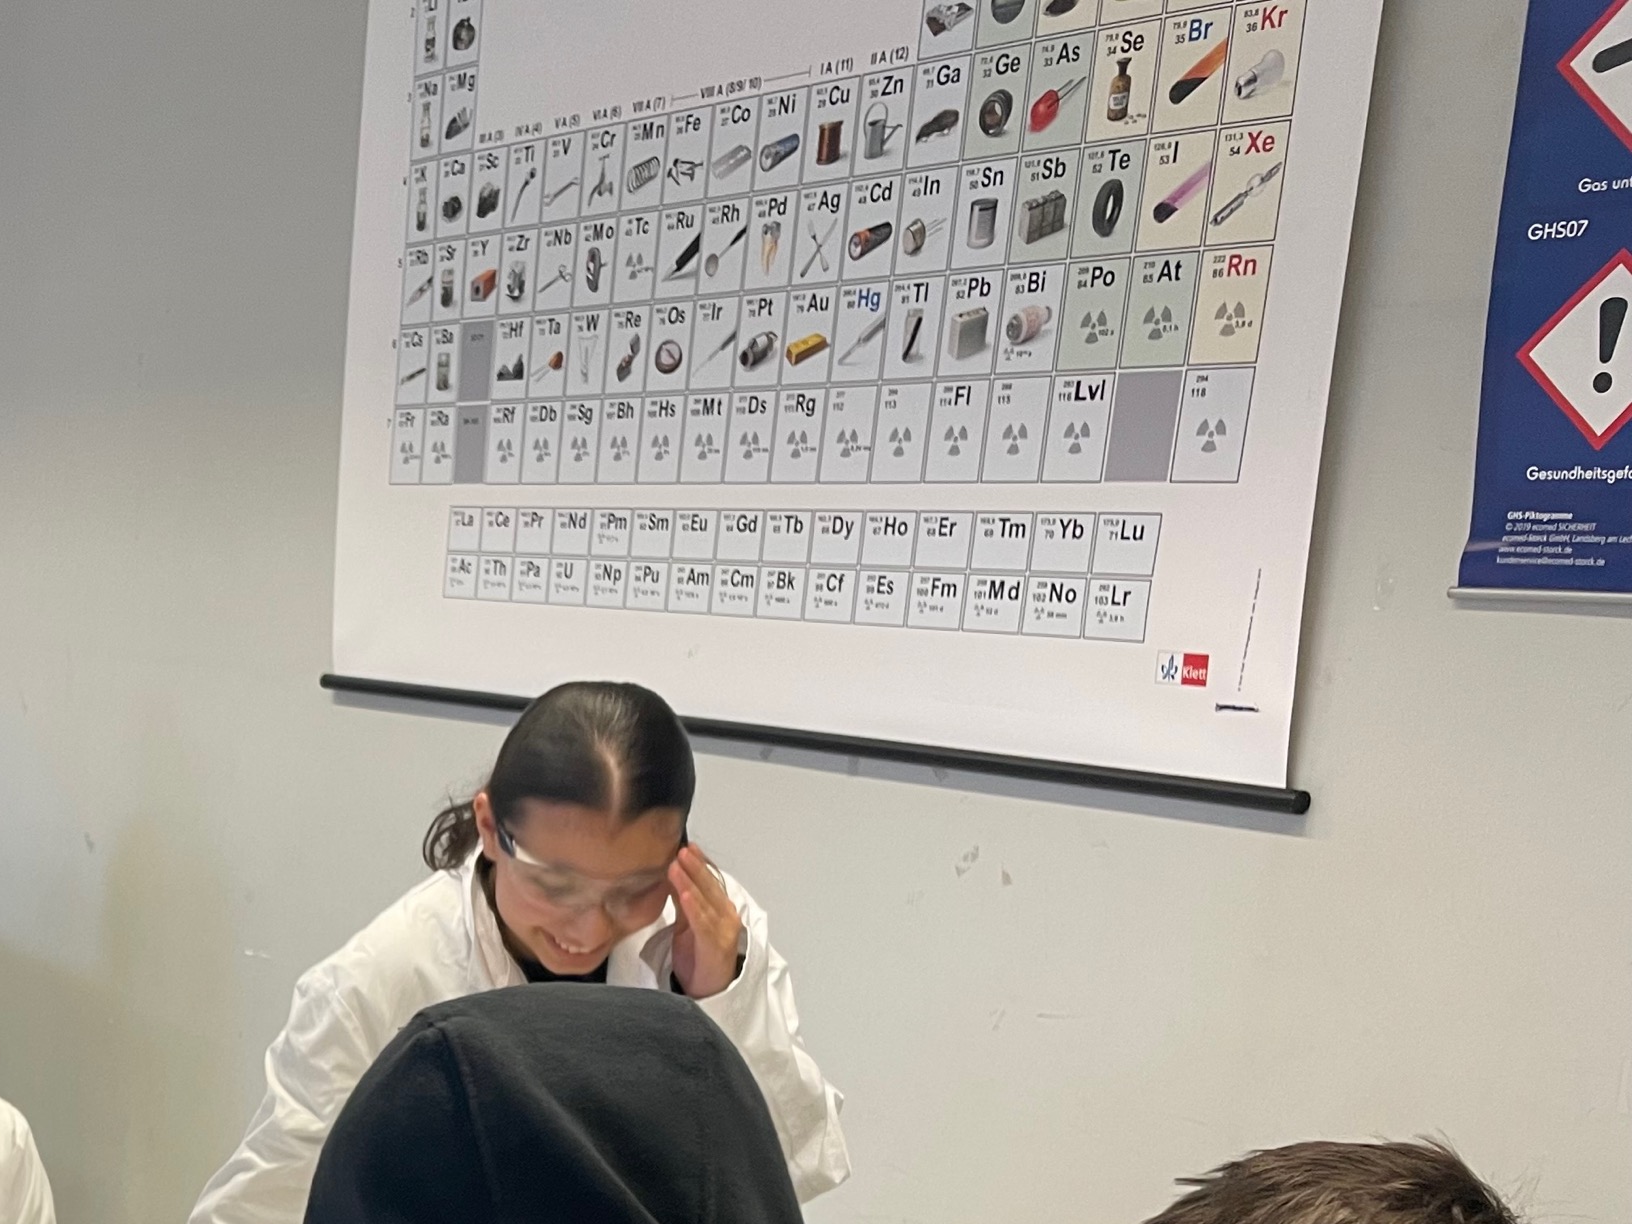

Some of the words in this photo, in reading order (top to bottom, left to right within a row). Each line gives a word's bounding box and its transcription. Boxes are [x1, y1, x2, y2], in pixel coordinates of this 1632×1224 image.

[1245, 21, 1258, 34] 36
[1260, 4, 1289, 32] Kr
[1174, 32, 1187, 46] 35
[1187, 18, 1214, 43] Br
[1120, 30, 1146, 54] Se
[994, 53, 1022, 76] Ge
[1055, 42, 1081, 66] As
[457, 72, 476, 92] Mg
[880, 74, 905, 98] Zn
[936, 64, 961, 87] Ga
[777, 93, 797, 117] Ni
[828, 84, 851, 107] Cu
[684, 113, 702, 134] Fe
[730, 104, 752, 126] Co
[600, 130, 617, 149] Cr
[641, 122, 666, 141] Mn
[561, 138, 572, 156] V
[1228, 145, 1241, 157] 54
[1244, 129, 1276, 156] Xe
[1041, 156, 1067, 181] Sb
[1108, 148, 1132, 172] Te
[1159, 153, 1171, 166] 53
[922, 174, 941, 197] In
[980, 166, 1005, 188] Sn
[1577, 177, 1608, 193] Gas
[817, 190, 842, 215] Ag
[869, 180, 894, 204] Cd
[719, 203, 741, 224] Rh
[767, 196, 788, 218] Pd
[634, 216, 650, 236] Tc
[675, 211, 695, 231] Ru
[1527, 219, 1589, 240] GHS07
[552, 227, 573, 247] Nb
[592, 222, 615, 242] Mo
[480, 238, 491, 257] Y
[515, 233, 531, 253] Zr
[1156, 258, 1183, 284] At
[1211, 267, 1225, 279] 86
[1226, 253, 1258, 278] Rn
[966, 276, 992, 299] Pb
[1026, 270, 1047, 294] Bi
[1090, 265, 1116, 289] Po
[805, 292, 830, 313] Au
[856, 287, 882, 313] Hg
[913, 282, 930, 303] Tl
[667, 305, 687, 326] Os
[710, 302, 724, 322] Ir
[757, 297, 775, 318] Pt
[509, 320, 525, 340] Hf
[547, 317, 561, 336] Ta
[585, 313, 601, 333] W
[624, 310, 643, 329] Re
[953, 384, 972, 407] Fl
[1190, 387, 1207, 398] 118
[501, 406, 517, 424] Rf
[538, 405, 558, 423] Db
[577, 403, 594, 426] Sg
[616, 401, 635, 420] Bh
[658, 399, 677, 419] Hs
[701, 397, 723, 417] Mt
[747, 395, 768, 415] Ds
[795, 393, 817, 418] Rg
[494, 511, 511, 528] Ce
[529, 511, 545, 530] Pr
[567, 512, 588, 530] Nd
[606, 512, 628, 531] Pm
[647, 513, 670, 532] Sm
[689, 513, 708, 533] Eu
[735, 514, 758, 534] Gd
[784, 514, 804, 535] Tb
[883, 516, 909, 537] Ho
[937, 516, 958, 538] Er
[1506, 511, 1573, 522] GHS-Piktogramme
[1514, 522, 1531, 531] 2019
[1558, 522, 1597, 531] SICHERHEIT
[831, 515, 855, 541] Dy
[998, 517, 1027, 539] Tm
[1059, 517, 1085, 540] Yb
[1120, 518, 1146, 542] Lu
[491, 559, 507, 577] Th
[525, 560, 541, 578] Pa
[563, 562, 574, 580] U
[601, 563, 622, 586] Np
[642, 565, 660, 584] Pu
[685, 567, 710, 587] Am
[730, 569, 755, 589] Cm
[776, 571, 796, 591] Bk
[826, 572, 846, 594] Cf
[876, 574, 895, 596] Es
[930, 577, 958, 599] Fm
[987, 579, 1021, 601] Md
[1048, 581, 1078, 604] No
[1110, 583, 1132, 607] Lr
[1181, 665, 1208, 681] Klett
